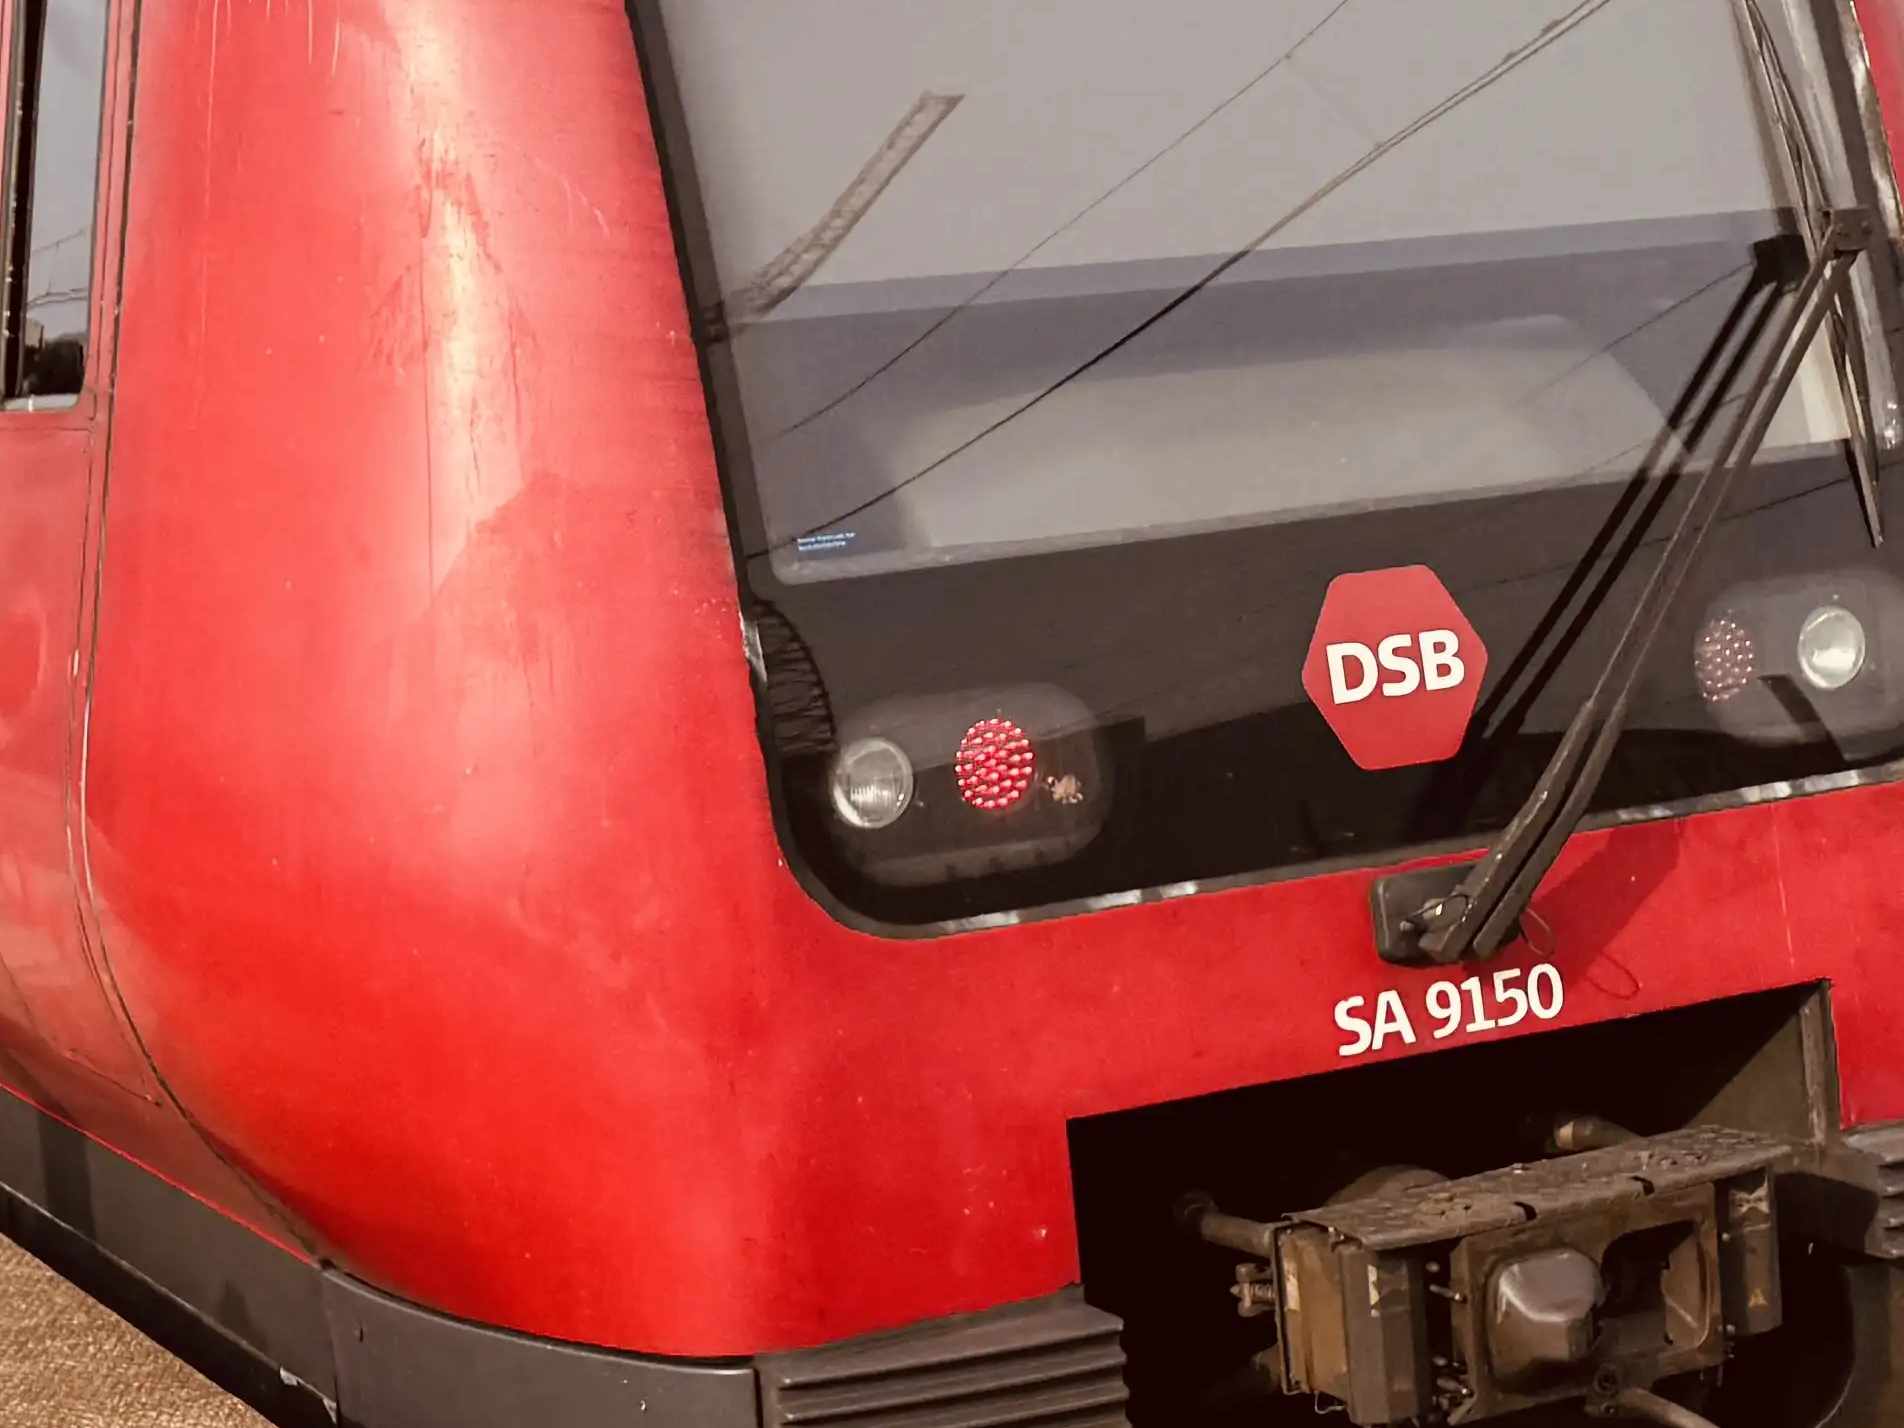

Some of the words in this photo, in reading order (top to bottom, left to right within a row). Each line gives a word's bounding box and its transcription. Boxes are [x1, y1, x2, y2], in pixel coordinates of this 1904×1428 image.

[1324, 627, 1468, 706] DSB
[1334, 990, 1416, 1057] SA
[1425, 962, 1565, 1040] 9150
